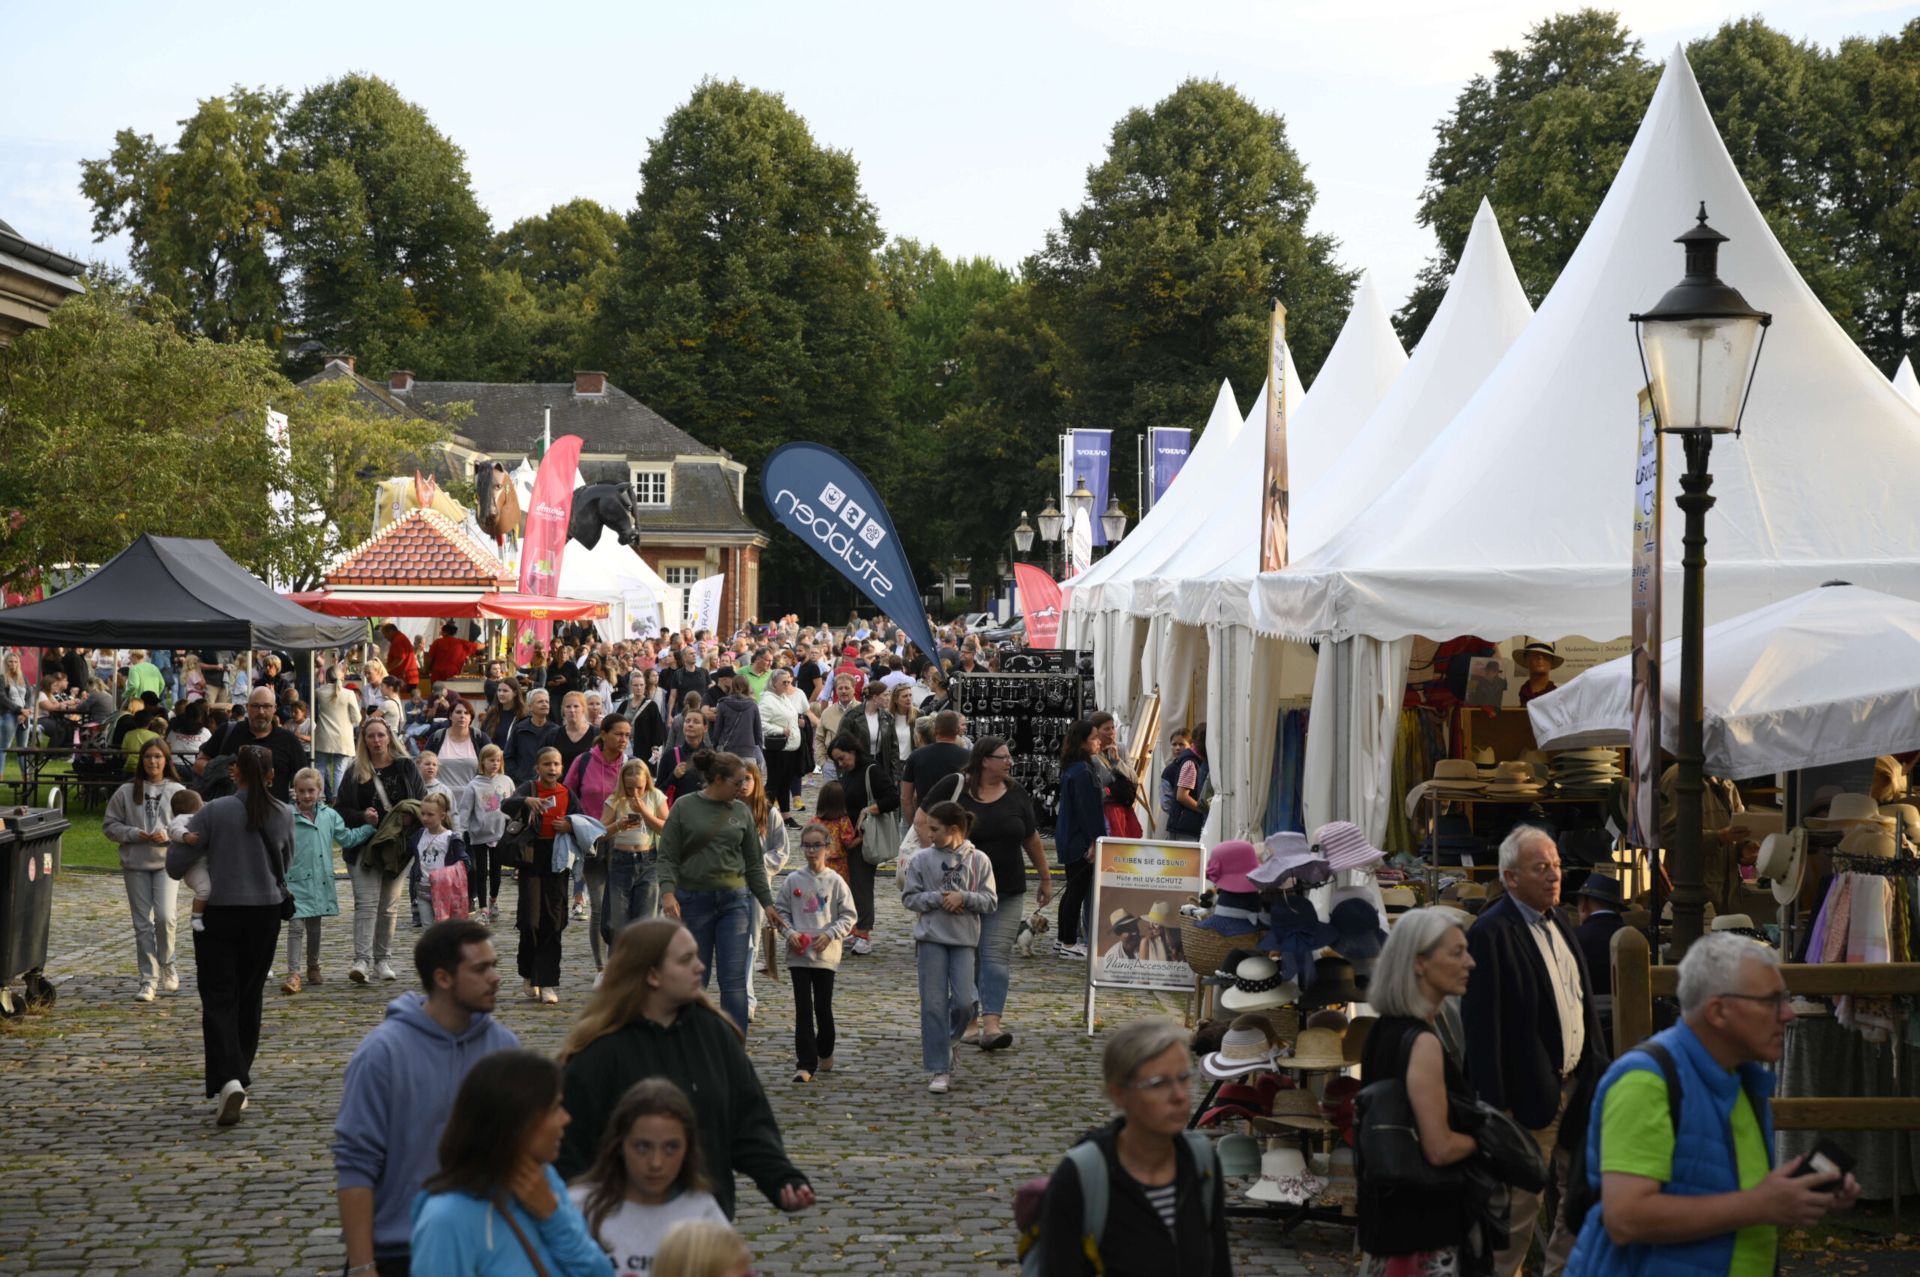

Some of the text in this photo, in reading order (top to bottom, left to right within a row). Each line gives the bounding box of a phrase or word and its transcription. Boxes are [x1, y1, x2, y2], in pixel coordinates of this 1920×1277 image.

[1076, 449, 1108, 457] VOLVO
[1157, 447, 1187, 455] VOLVO
[1113, 856, 1142, 864] BLEIBEN
[1116, 874, 1183, 885] Hüte mit UV-SCHUTZ
[1134, 959, 1187, 972] Accessoires
